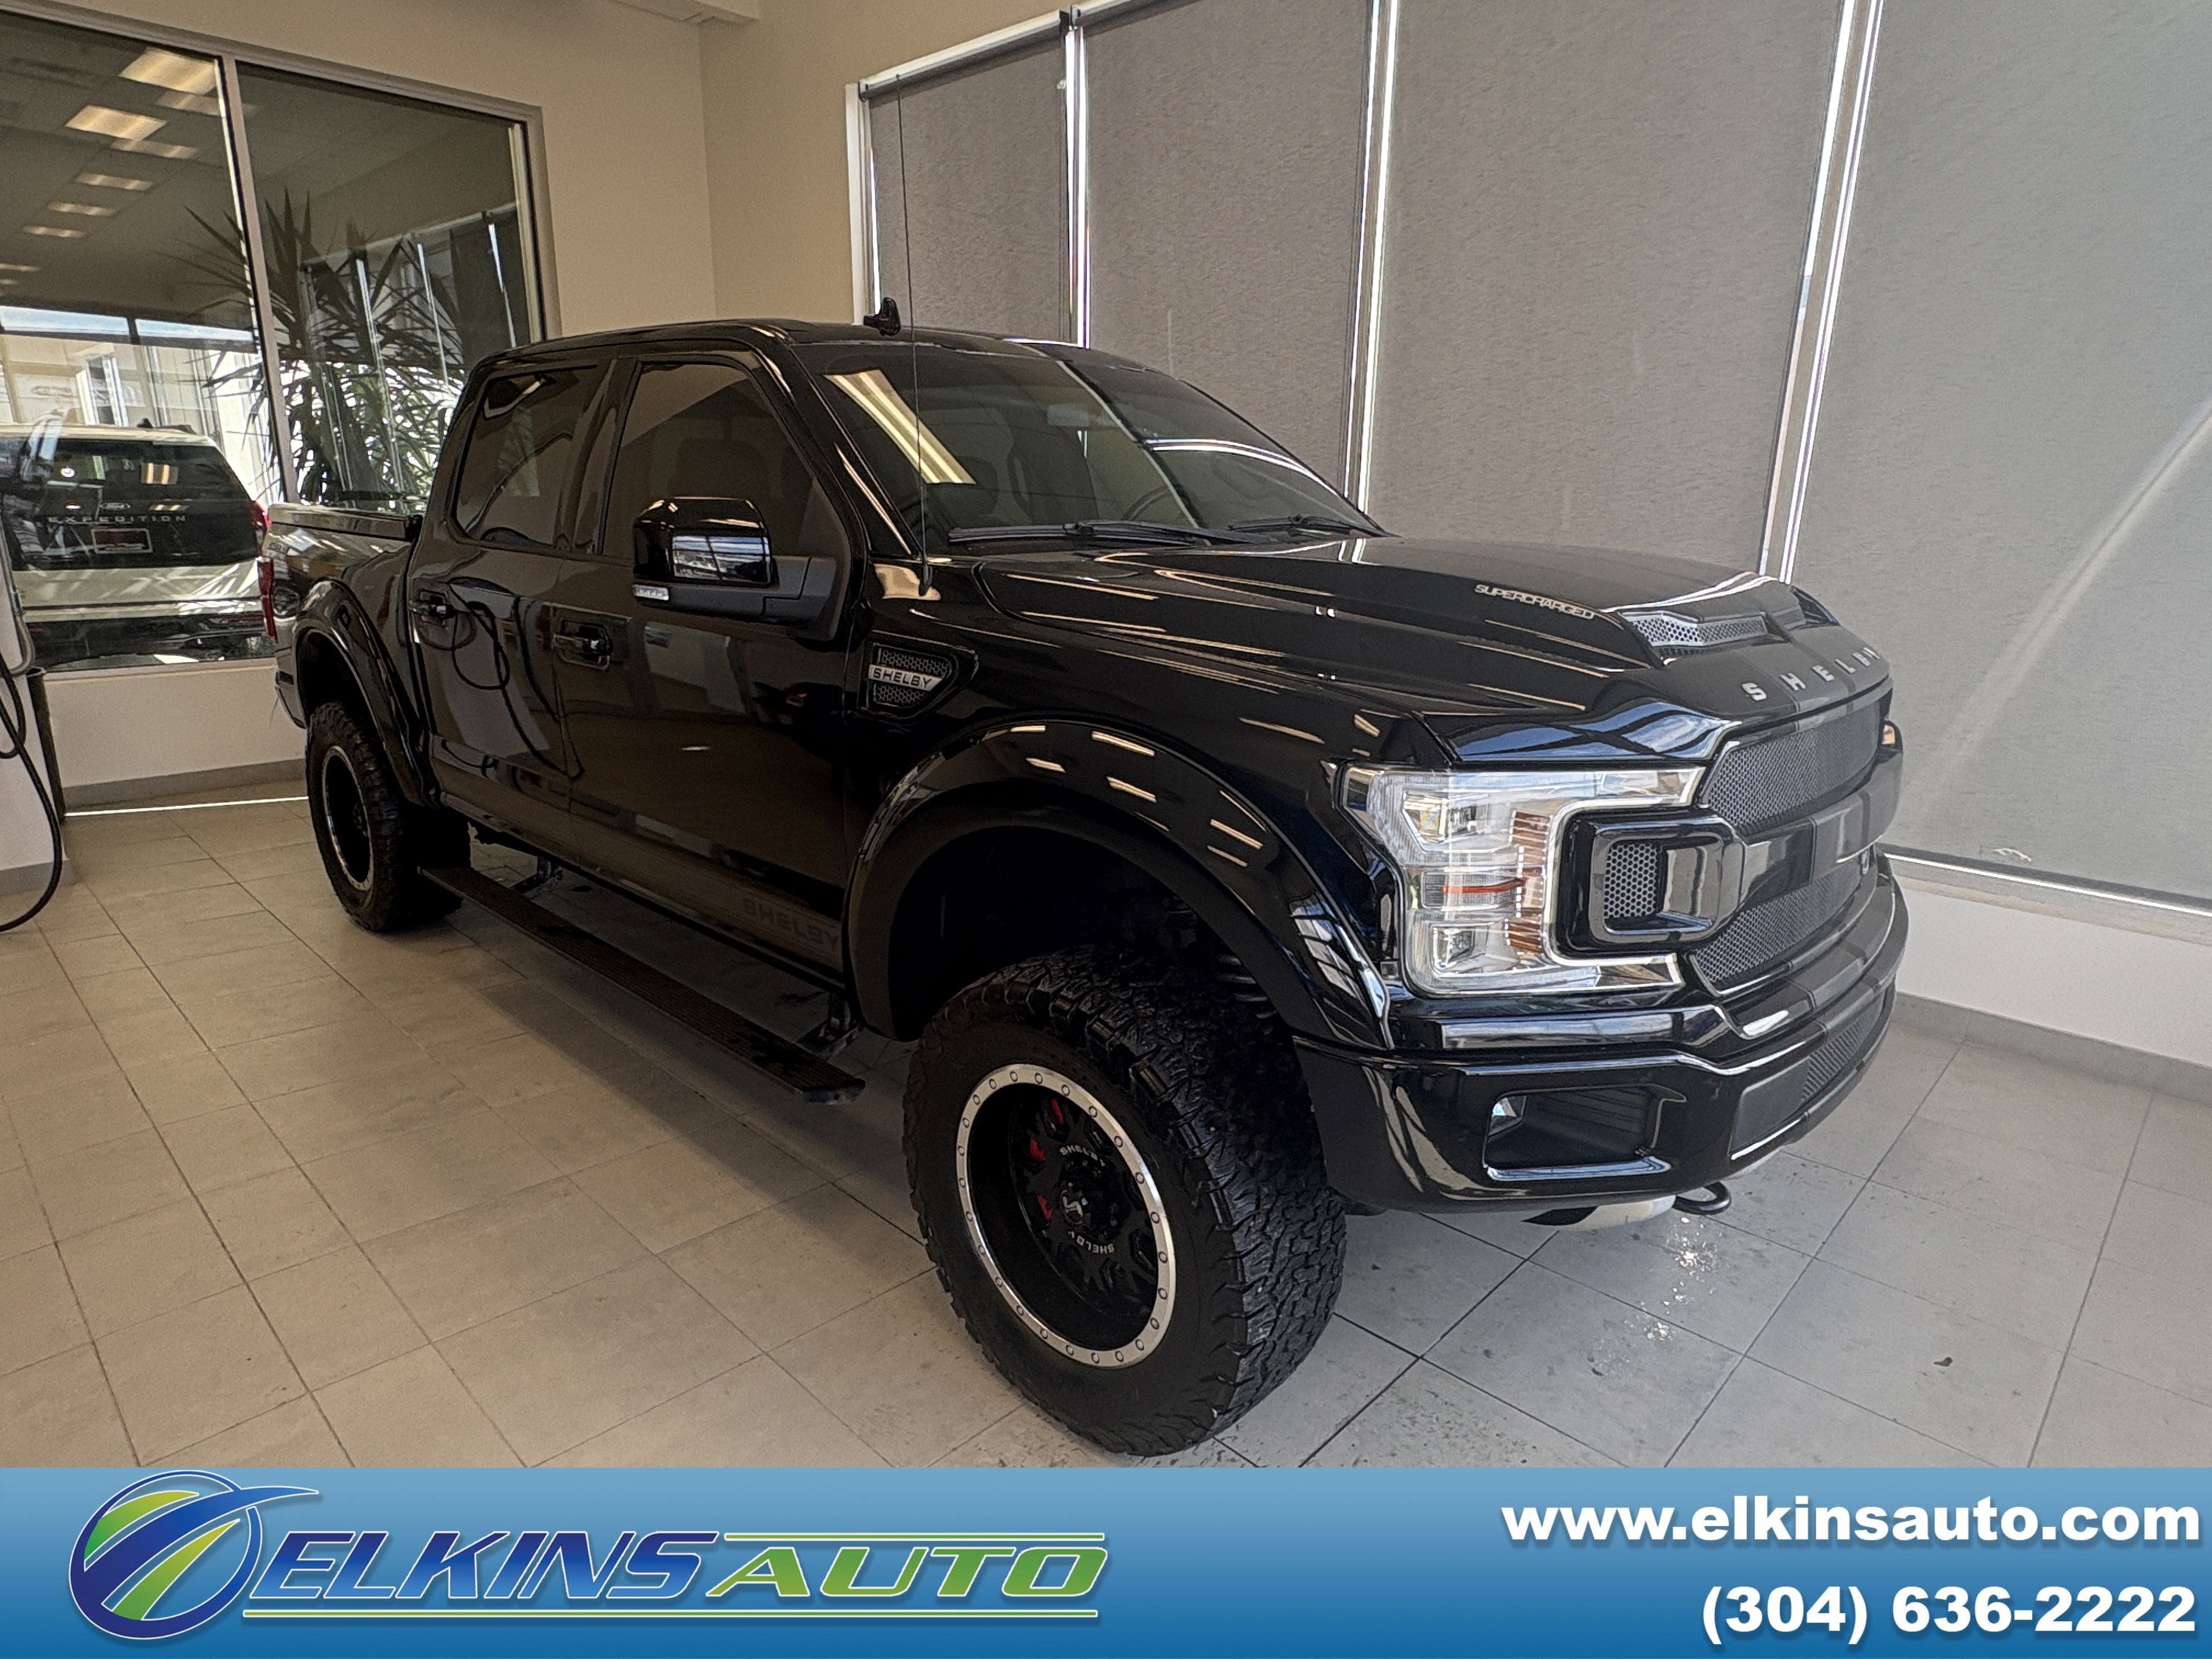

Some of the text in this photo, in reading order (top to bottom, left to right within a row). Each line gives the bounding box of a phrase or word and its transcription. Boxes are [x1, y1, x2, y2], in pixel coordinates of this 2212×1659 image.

[48, 515, 185, 524] EXPEDITION
[872, 667, 933, 688] SHELBY
[742, 898, 839, 951] SHELBY
